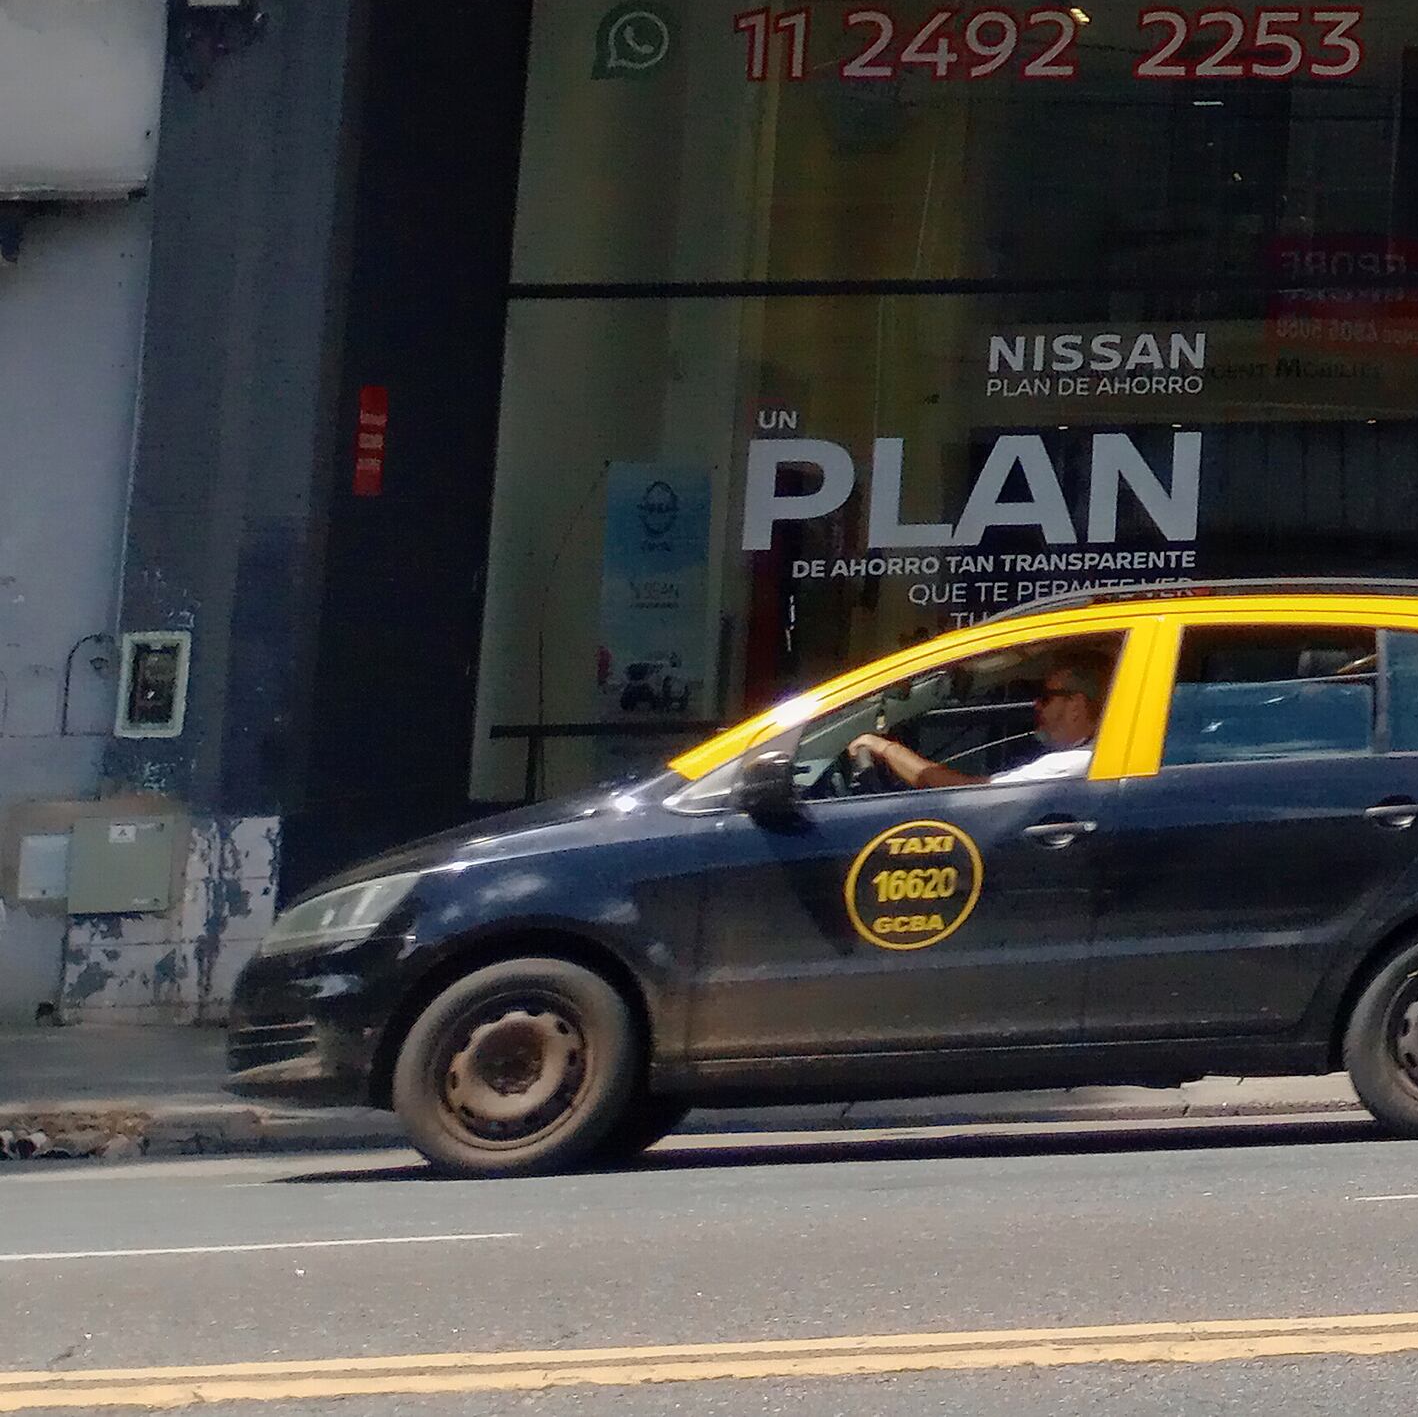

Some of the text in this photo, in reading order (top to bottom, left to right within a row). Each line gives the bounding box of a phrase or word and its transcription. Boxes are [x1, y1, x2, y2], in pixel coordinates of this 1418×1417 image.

[734, 9, 1361, 80] 11 2492 2253
[987, 332, 1206, 373] NISSAN
[986, 376, 1203, 397] PLAN DE AHORRO
[758, 410, 797, 429] UN
[742, 432, 1202, 551] PLAN
[793, 550, 1197, 578] DE AHORRO TAN TRANSPARENTE
[908, 582, 967, 605] QUE
[974, 581, 1009, 602] TE
[885, 835, 955, 855] TAXI
[873, 866, 959, 902] 16620
[873, 914, 945, 934] GCBA
